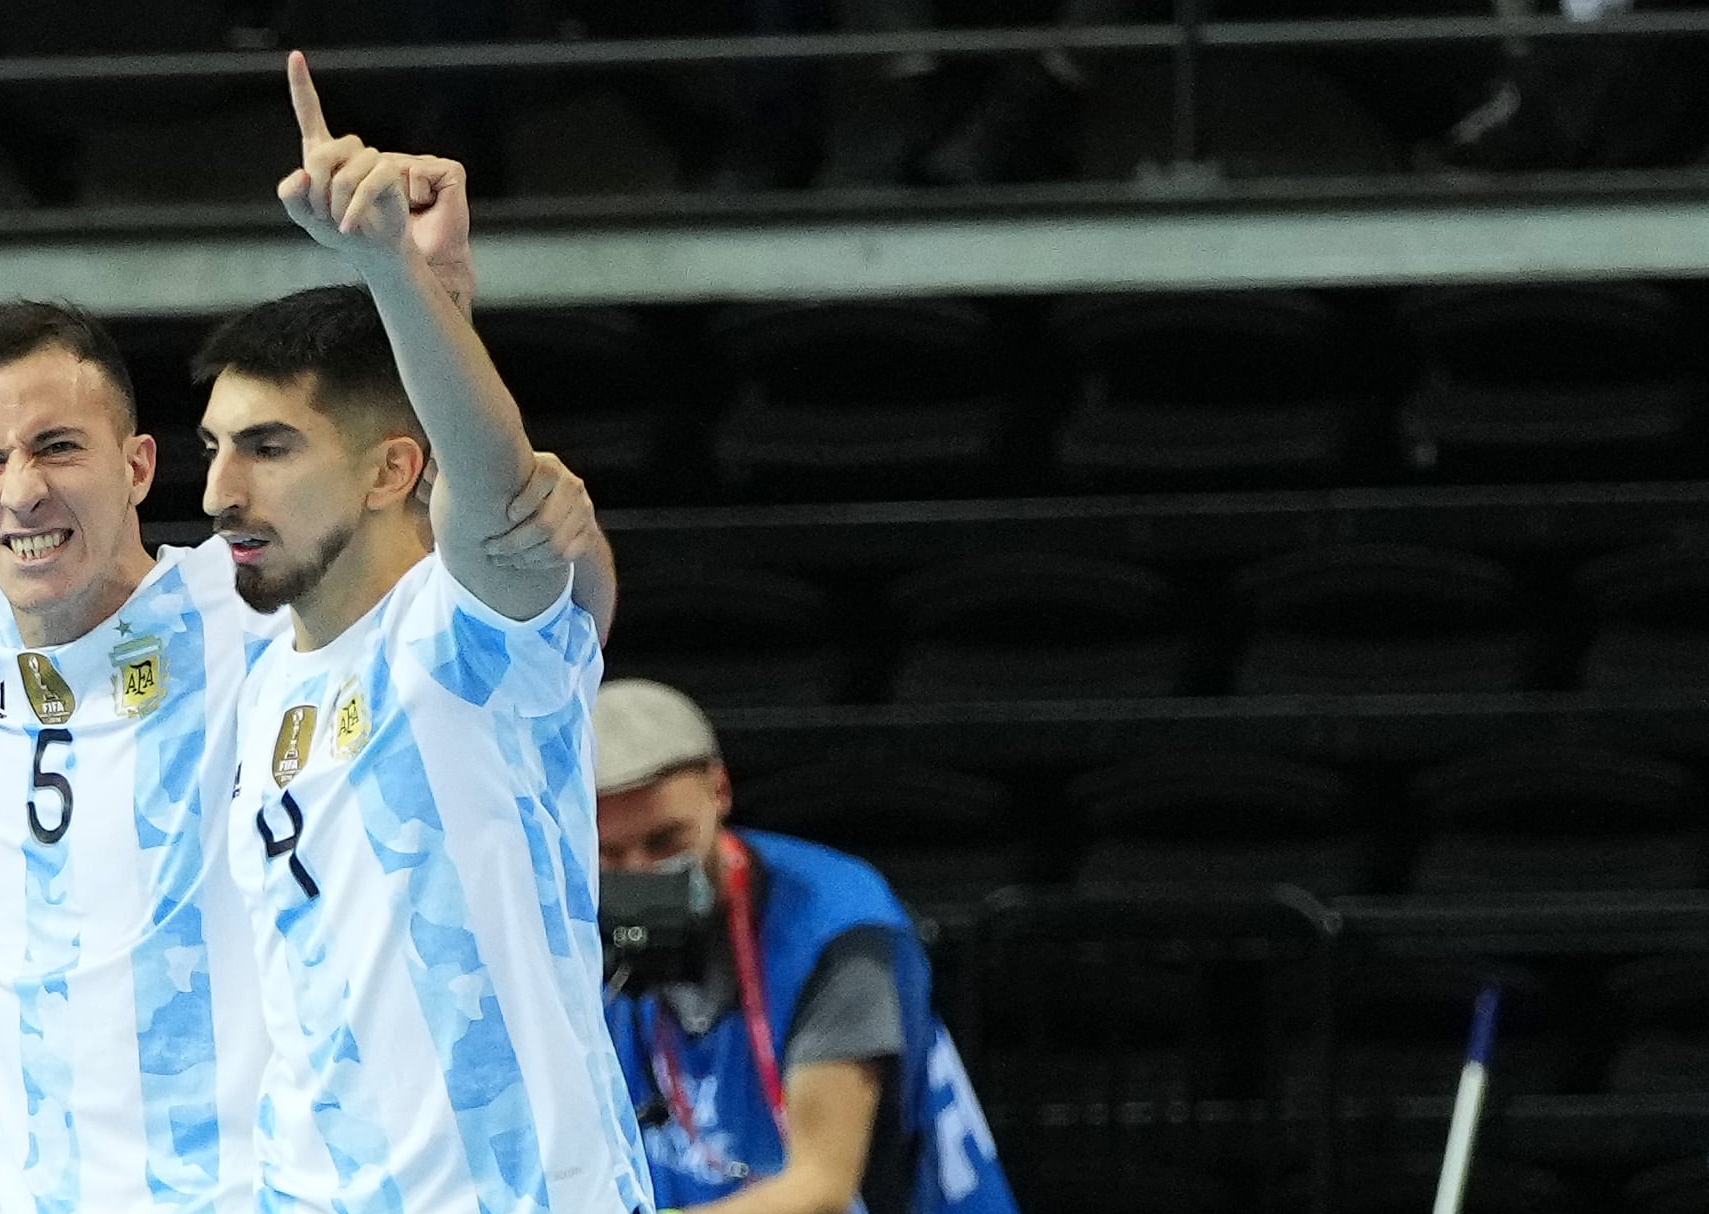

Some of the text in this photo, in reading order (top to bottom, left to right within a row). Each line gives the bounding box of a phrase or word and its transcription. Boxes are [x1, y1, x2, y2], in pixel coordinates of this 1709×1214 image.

[42, 701, 65, 714] FIFA
[125, 659, 154, 695] AFA
[27, 728, 73, 847] 5
[256, 788, 321, 899] 4
